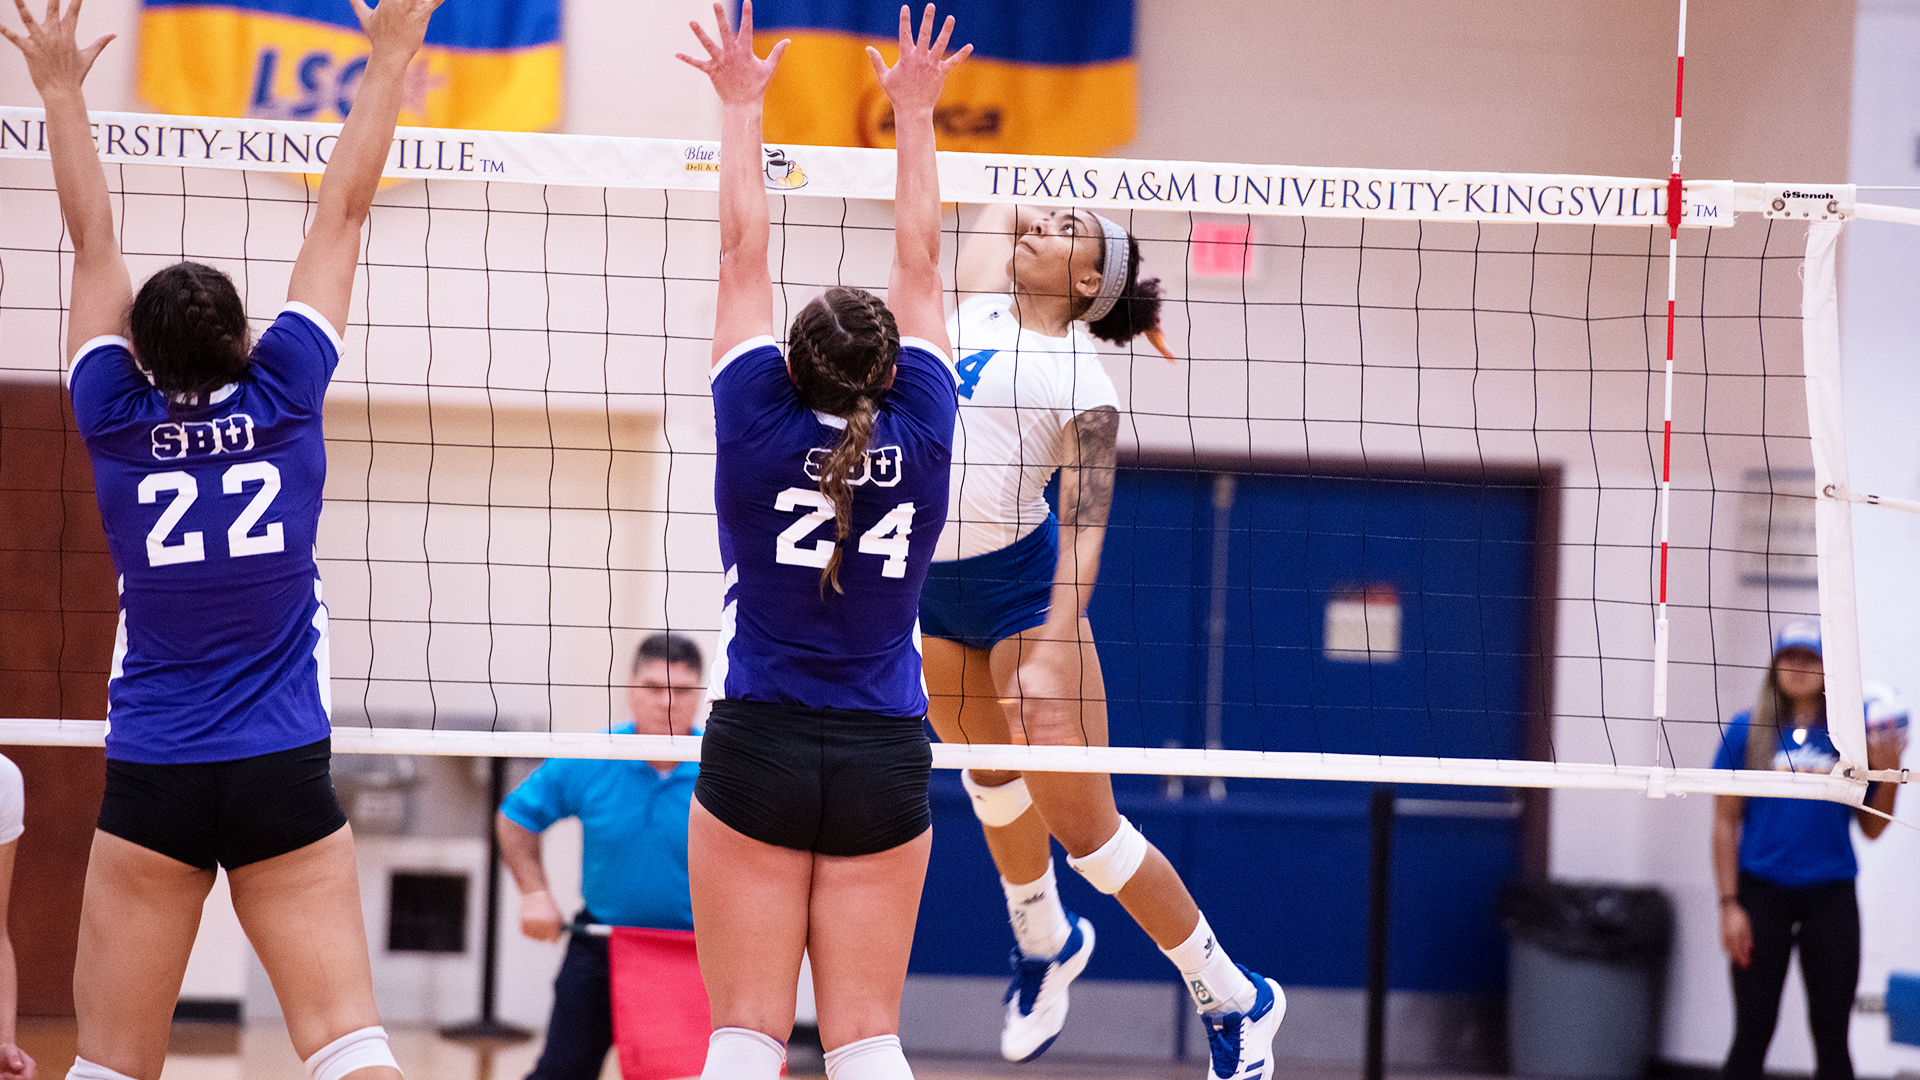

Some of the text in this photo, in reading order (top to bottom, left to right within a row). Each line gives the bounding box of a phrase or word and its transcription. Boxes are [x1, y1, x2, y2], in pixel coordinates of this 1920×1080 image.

[0, 118, 475, 172] NIRSITY-KINILLE
[685, 145, 714, 161] Blue
[984, 165, 1098, 199] TEXAS
[1110, 170, 1200, 203] A&M
[1792, 191, 1834, 199] Senoh
[955, 349, 1000, 400] 4
[151, 413, 255, 460] SBU
[137, 460, 285, 567] 22
[774, 487, 916, 578] 24
